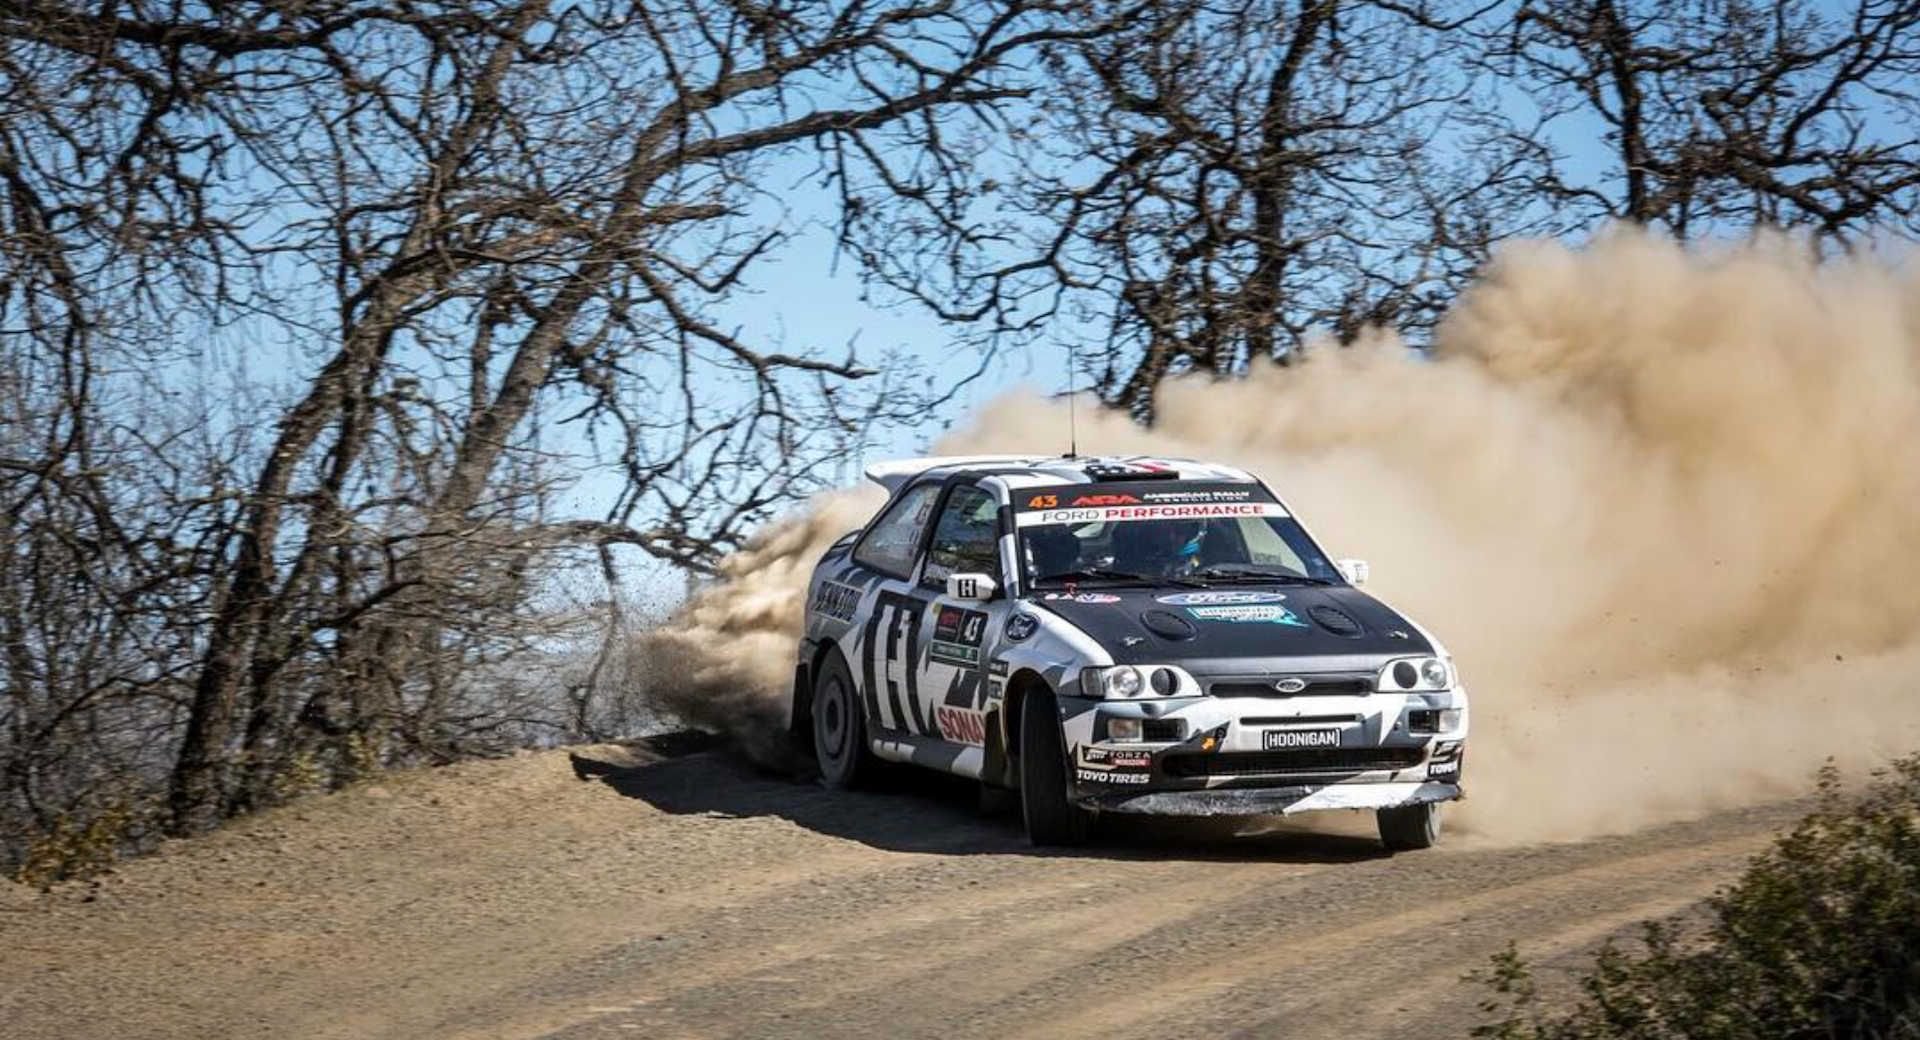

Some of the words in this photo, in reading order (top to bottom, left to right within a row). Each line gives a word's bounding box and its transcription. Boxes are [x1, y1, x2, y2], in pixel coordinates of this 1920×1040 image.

[1028, 495, 1057, 508] 43
[1043, 510, 1100, 522] FORD
[1105, 505, 1264, 519] PERFORMANCE
[960, 580, 977, 597] H
[1109, 751, 1151, 759] FORZA
[1077, 769, 1108, 782] TOYO
[1109, 773, 1150, 784] TIRES
